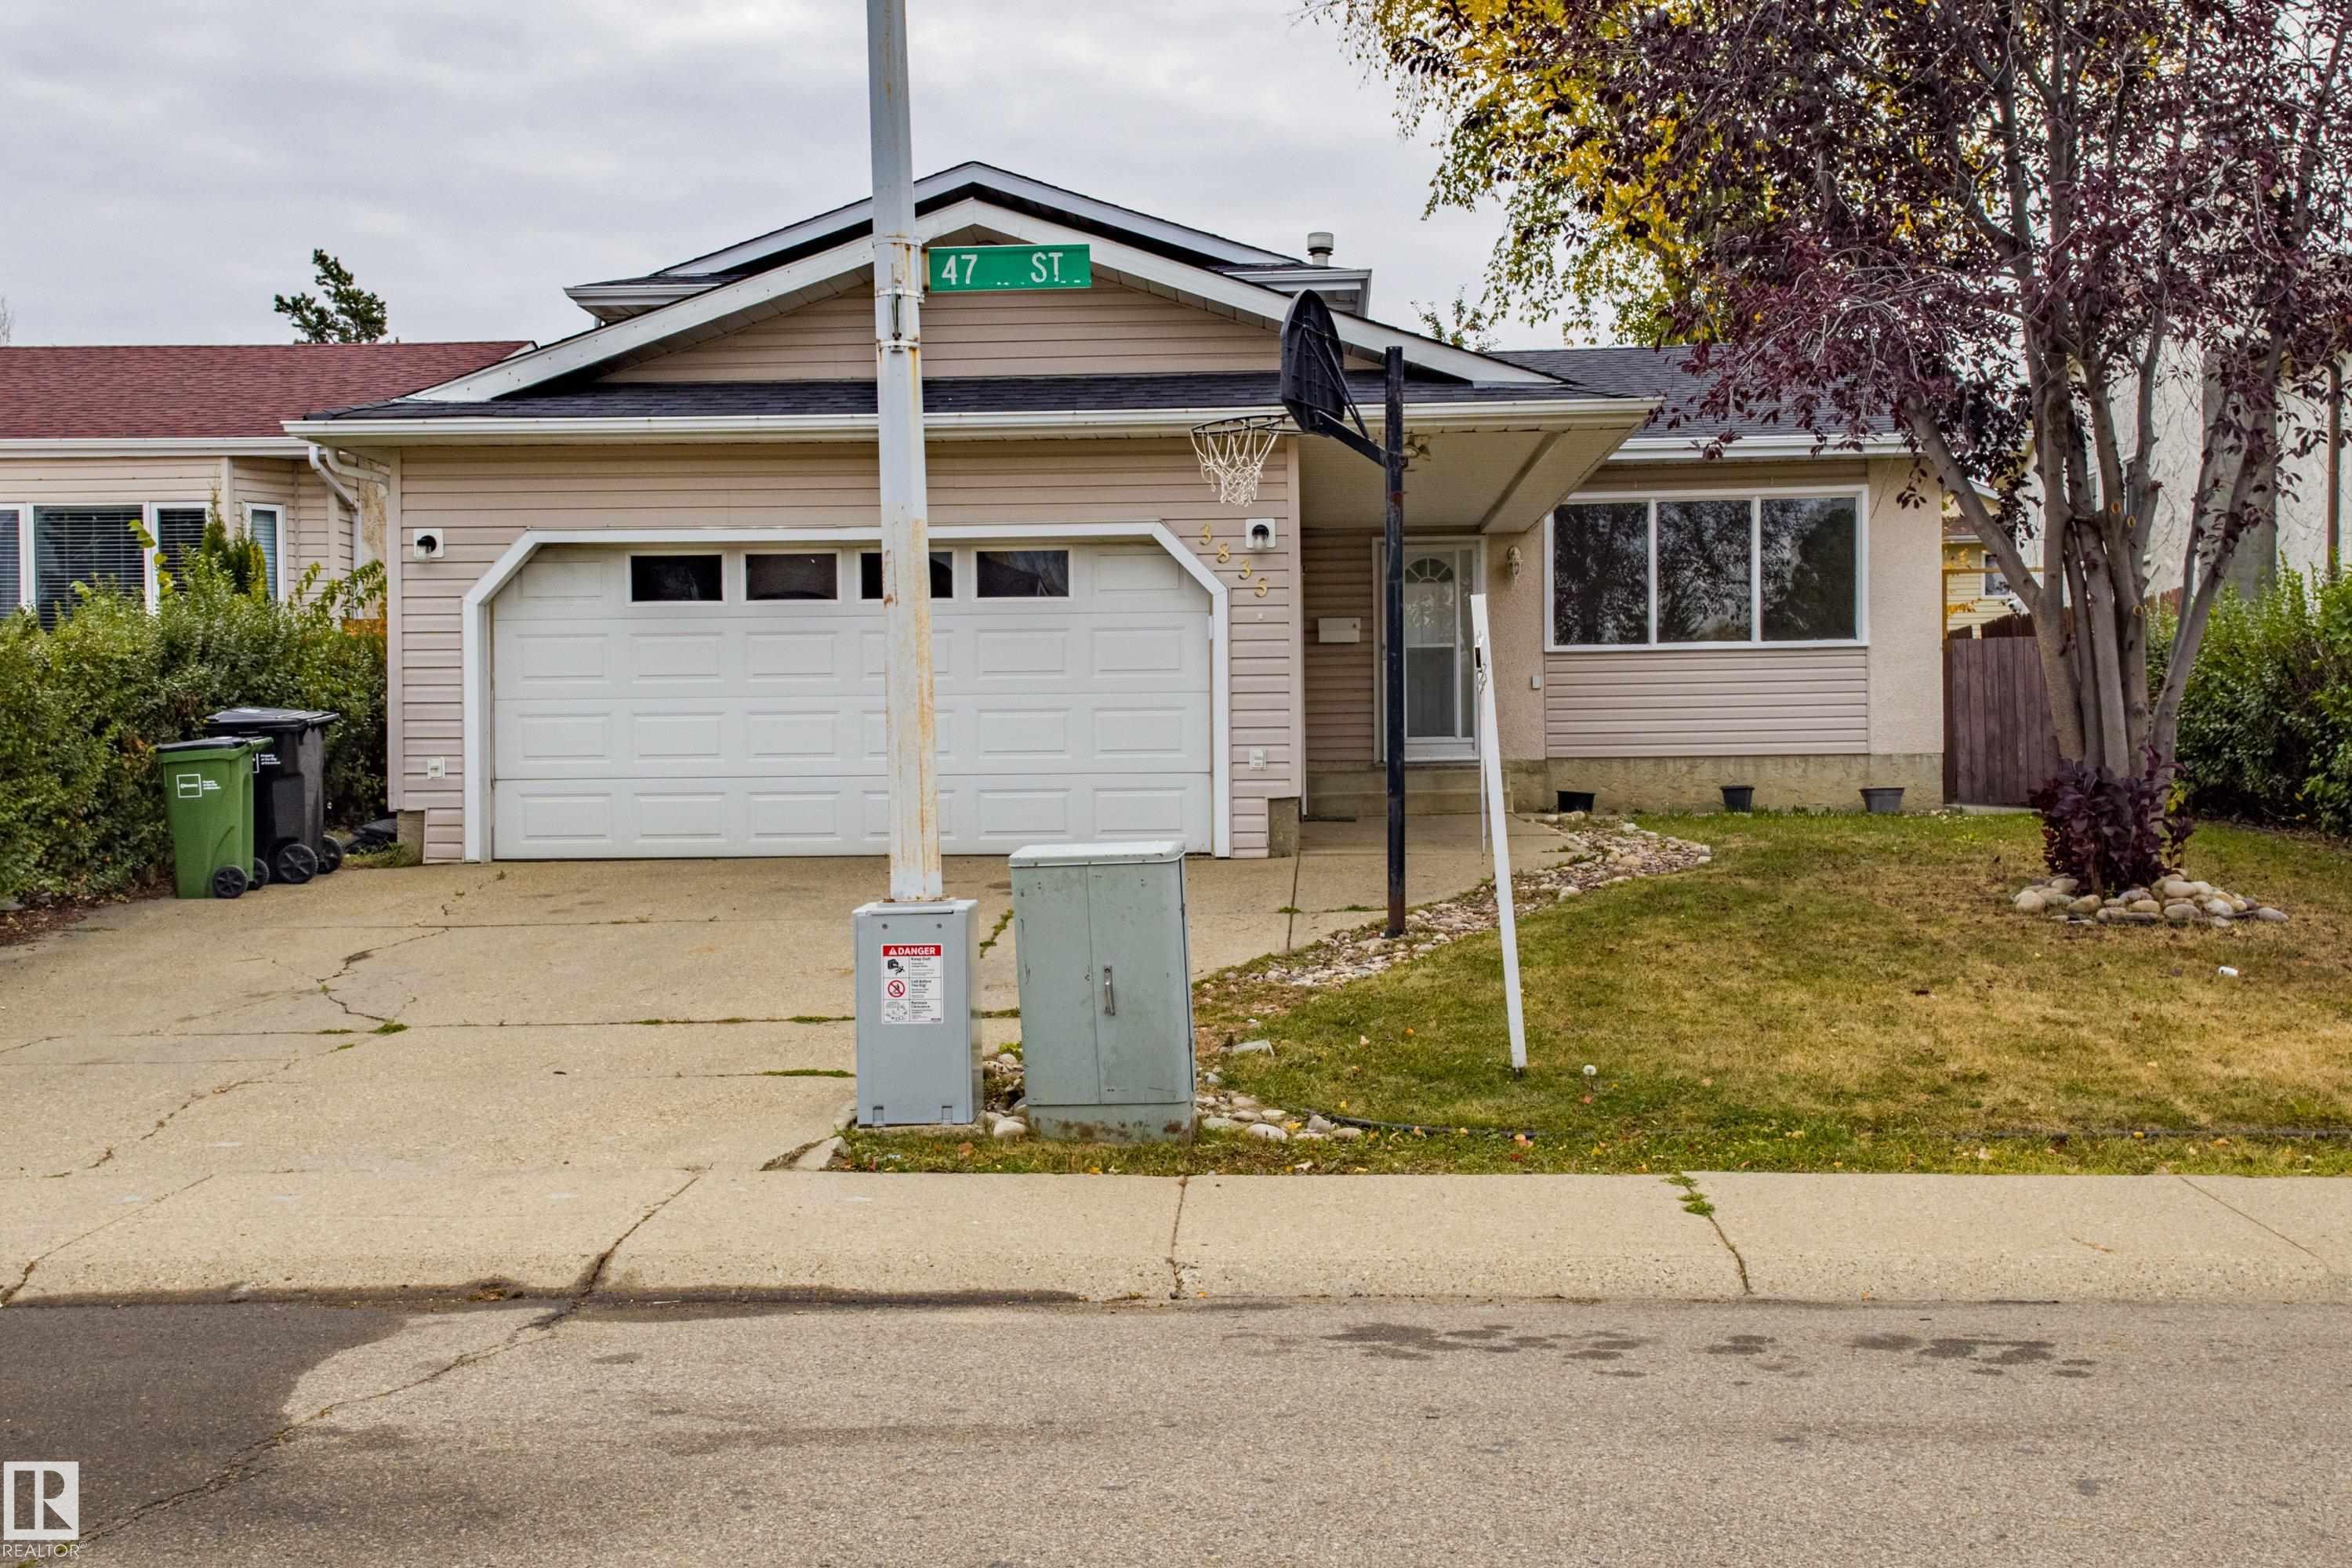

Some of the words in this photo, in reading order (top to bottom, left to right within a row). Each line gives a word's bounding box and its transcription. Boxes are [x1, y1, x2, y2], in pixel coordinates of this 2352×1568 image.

[942, 254, 978, 285] 47
[1030, 252, 1063, 283] ST
[898, 946, 935, 956] DANGER
